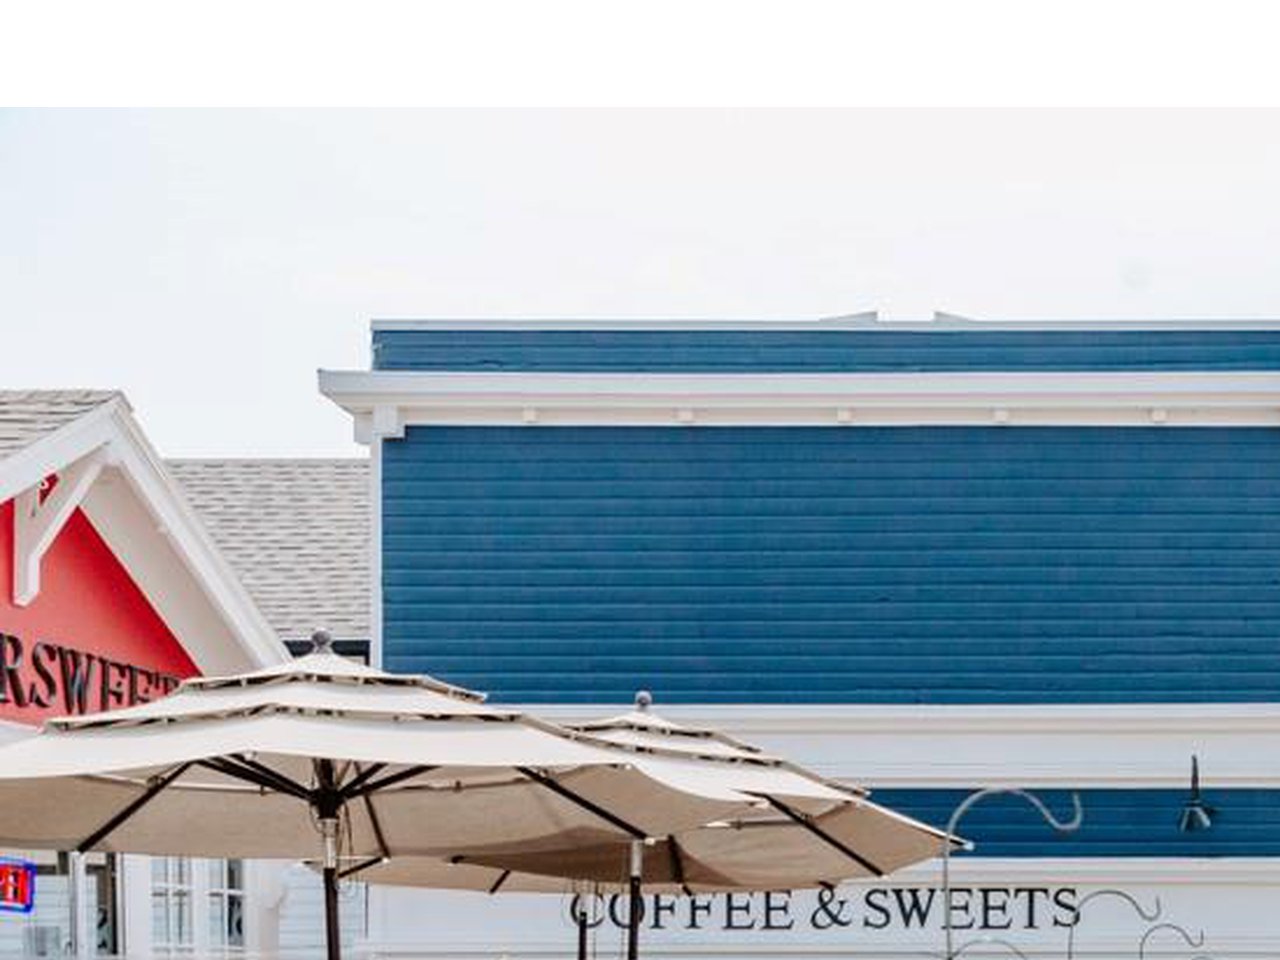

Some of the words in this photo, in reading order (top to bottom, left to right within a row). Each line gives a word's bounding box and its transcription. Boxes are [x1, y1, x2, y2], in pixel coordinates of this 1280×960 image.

[570, 890, 795, 930] COFFEE
[810, 887, 851, 930] &
[863, 887, 1081, 930] SWEETS
